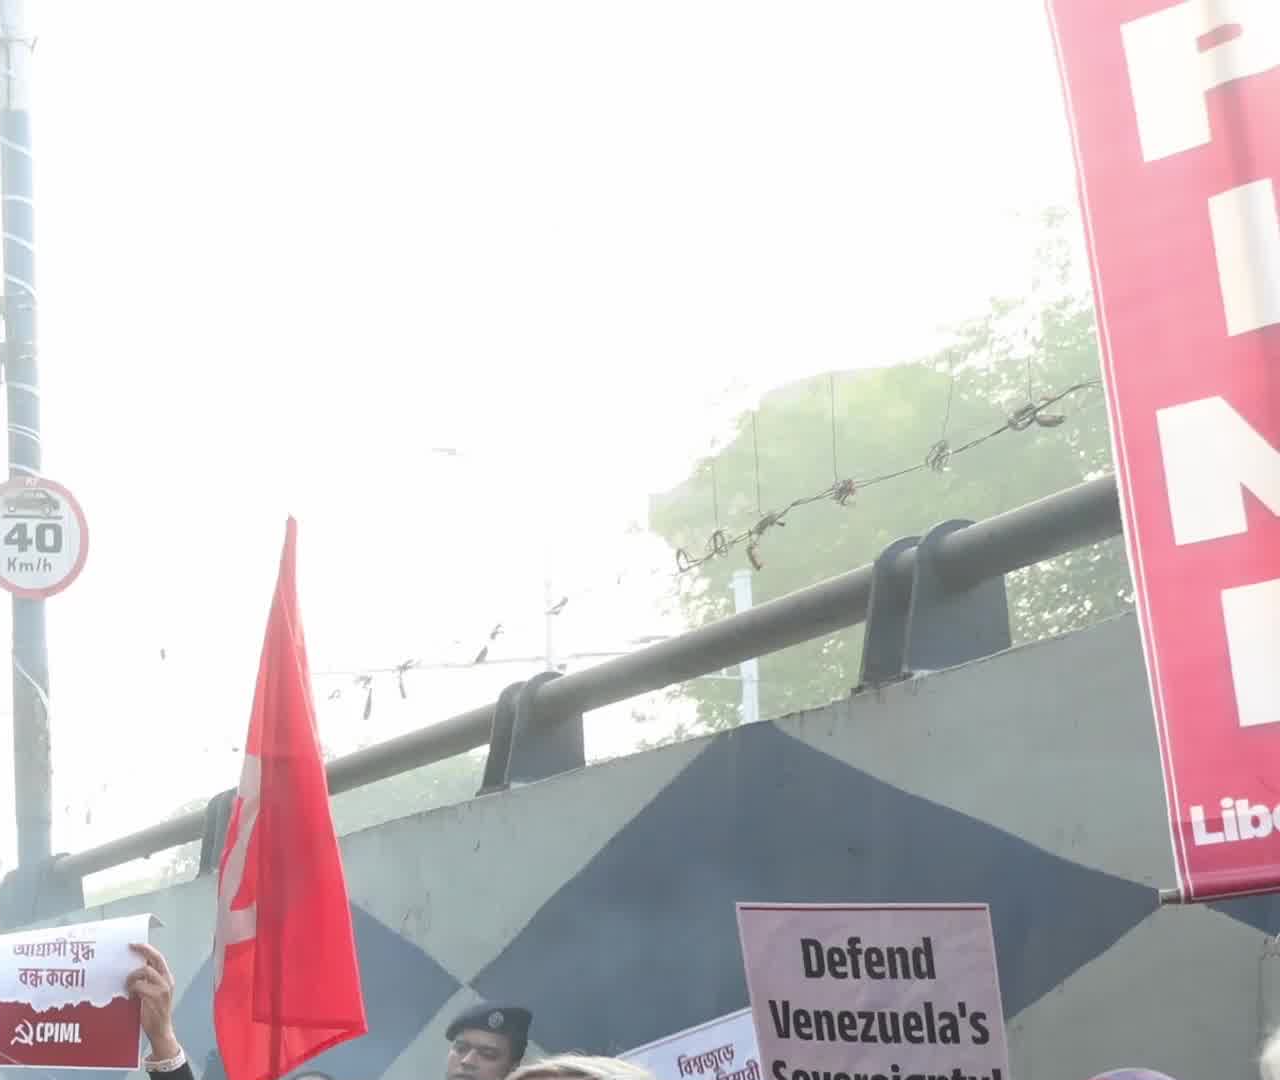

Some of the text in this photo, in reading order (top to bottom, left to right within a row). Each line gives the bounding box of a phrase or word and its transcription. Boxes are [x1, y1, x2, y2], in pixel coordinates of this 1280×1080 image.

[4, 523, 63, 553] 40
[7, 557, 52, 573] Km/h
[800, 936, 937, 981] Defend
[36, 1022, 82, 1043] CPIML
[768, 999, 990, 1045] Venezuela's
